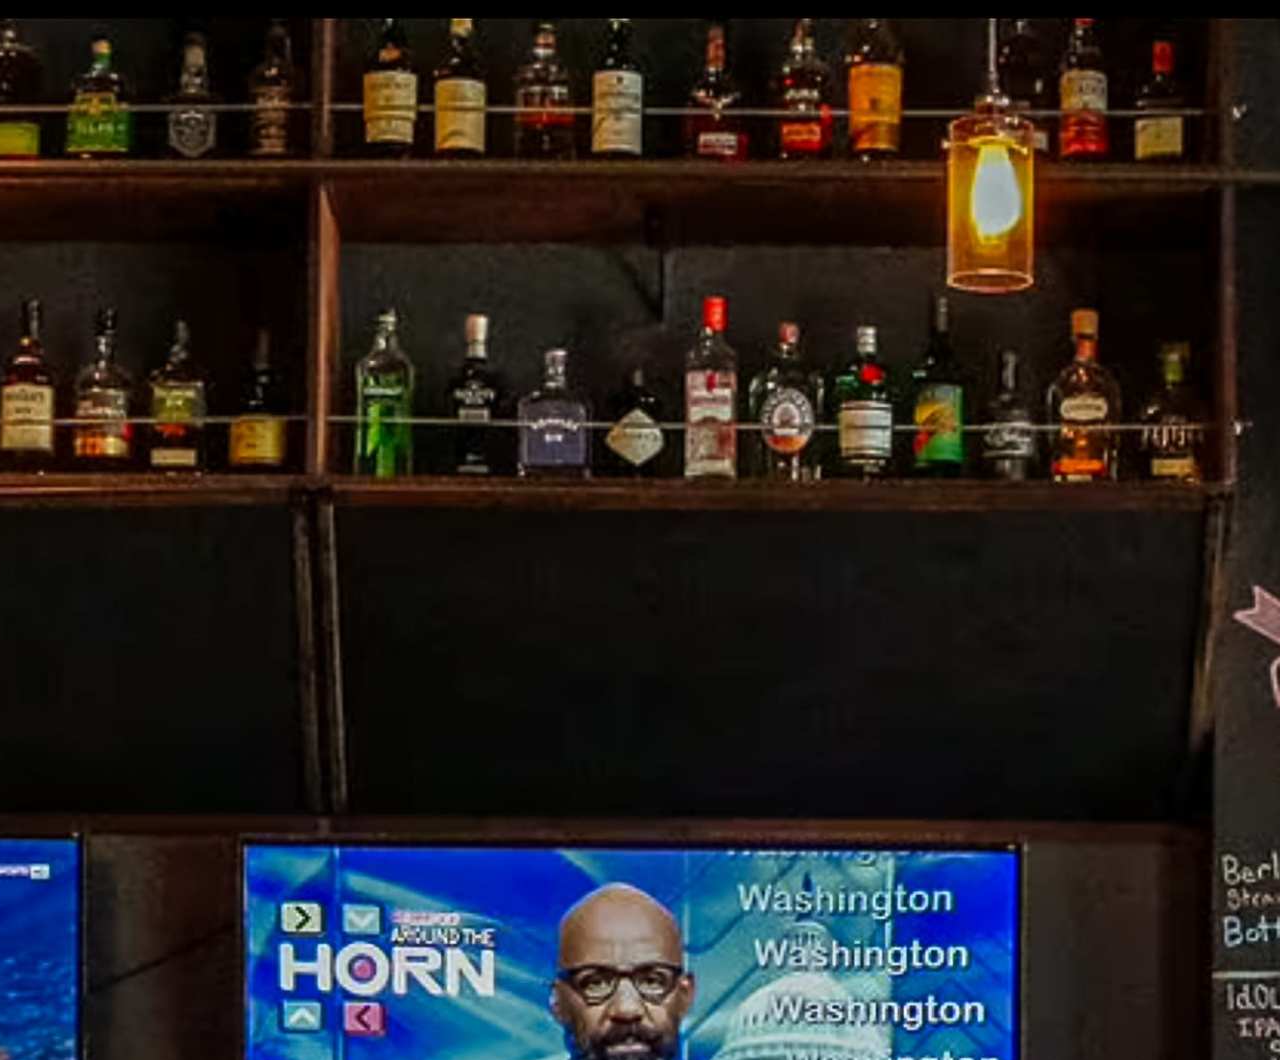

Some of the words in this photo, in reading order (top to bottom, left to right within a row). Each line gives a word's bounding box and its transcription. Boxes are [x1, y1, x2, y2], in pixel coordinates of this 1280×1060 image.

[736, 883, 953, 921] Washington
[390, 927, 460, 945] AROUND
[463, 928, 496, 946] THE
[279, 942, 496, 997] HORN
[754, 939, 970, 976] Washington
[770, 994, 986, 1031] Washington
